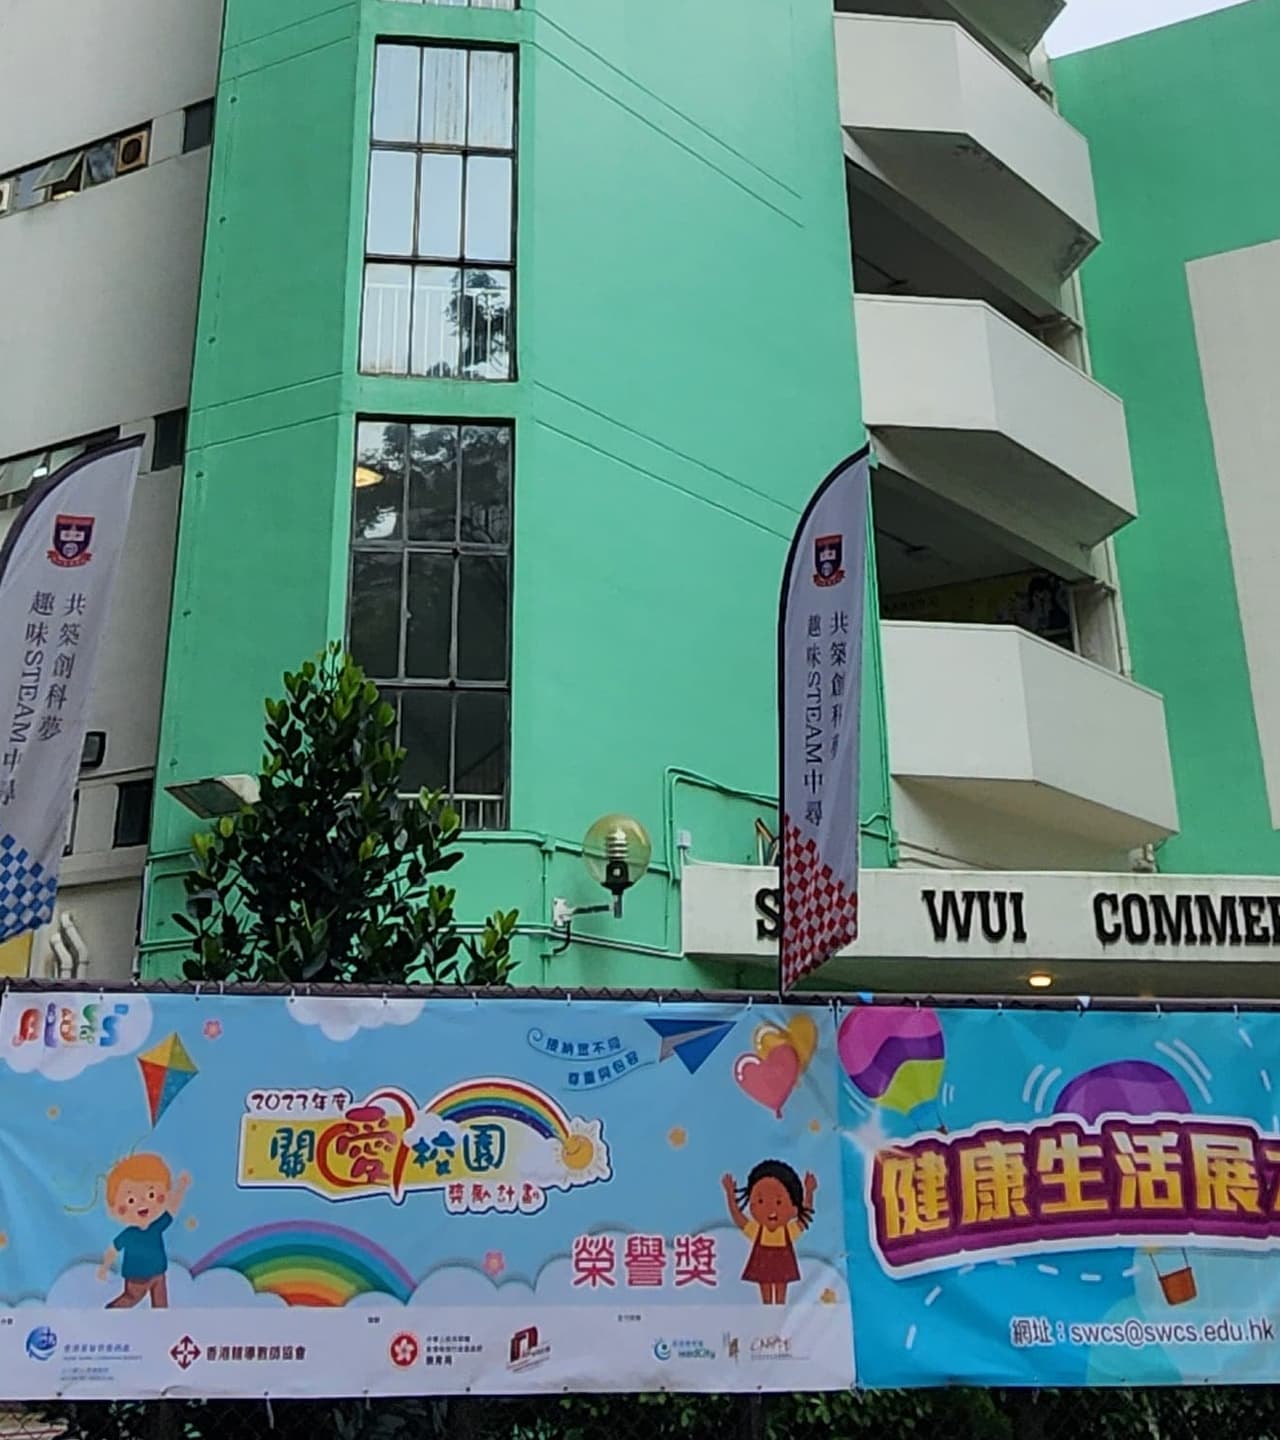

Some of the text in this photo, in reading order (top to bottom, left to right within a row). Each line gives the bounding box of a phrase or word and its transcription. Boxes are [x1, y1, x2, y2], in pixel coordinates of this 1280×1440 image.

[38, 592, 86, 742] 共築創科夢
[921, 890, 1028, 944] WUI
[271, 1105, 506, 1186] 關愛校園
[573, 1236, 718, 1287] 榮譽獎
[1071, 1318, 1275, 1346] swcs@swcs.edu.hk
